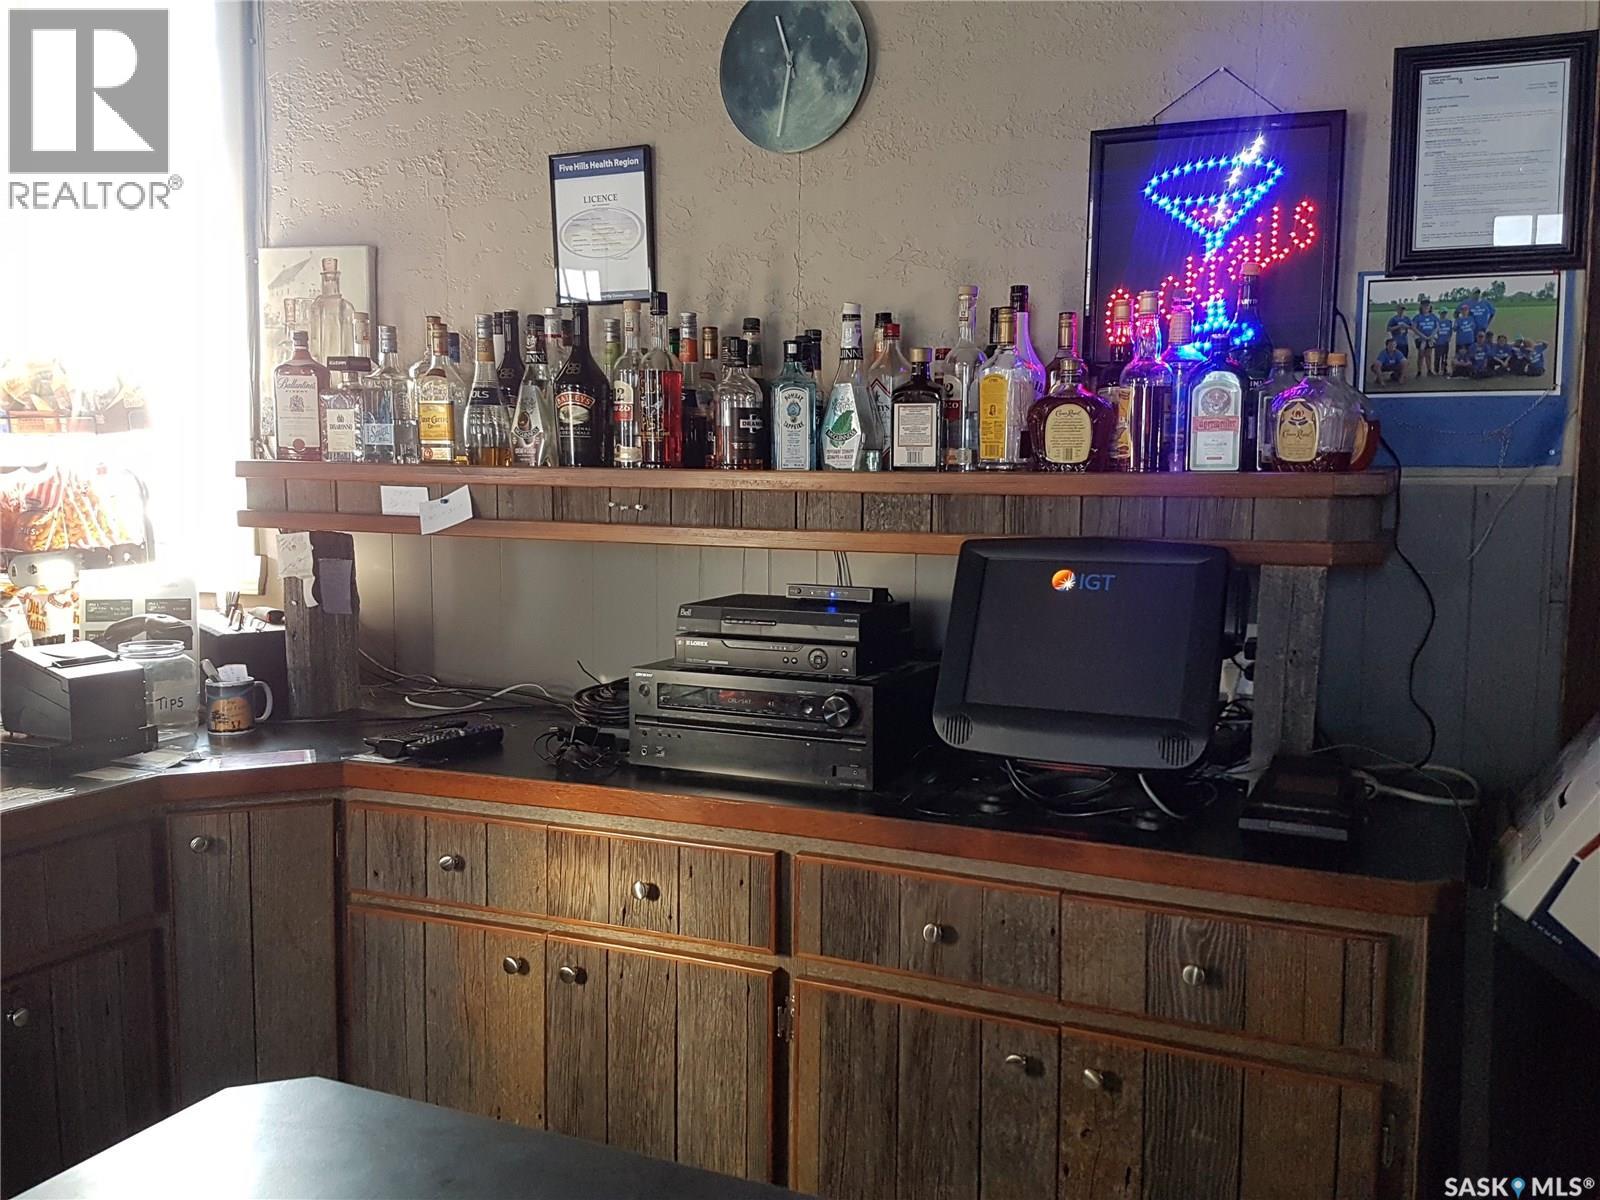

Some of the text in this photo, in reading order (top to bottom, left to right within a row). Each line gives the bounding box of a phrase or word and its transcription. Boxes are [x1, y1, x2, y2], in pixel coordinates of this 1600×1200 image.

[559, 157, 639, 172] Five Hills Health Region
[583, 193, 618, 204] LICENCE
[471, 390, 489, 399] OLS
[557, 394, 593, 405] BAILEYS
[1079, 574, 1116, 591] IGT
[680, 608, 692, 617] Bell
